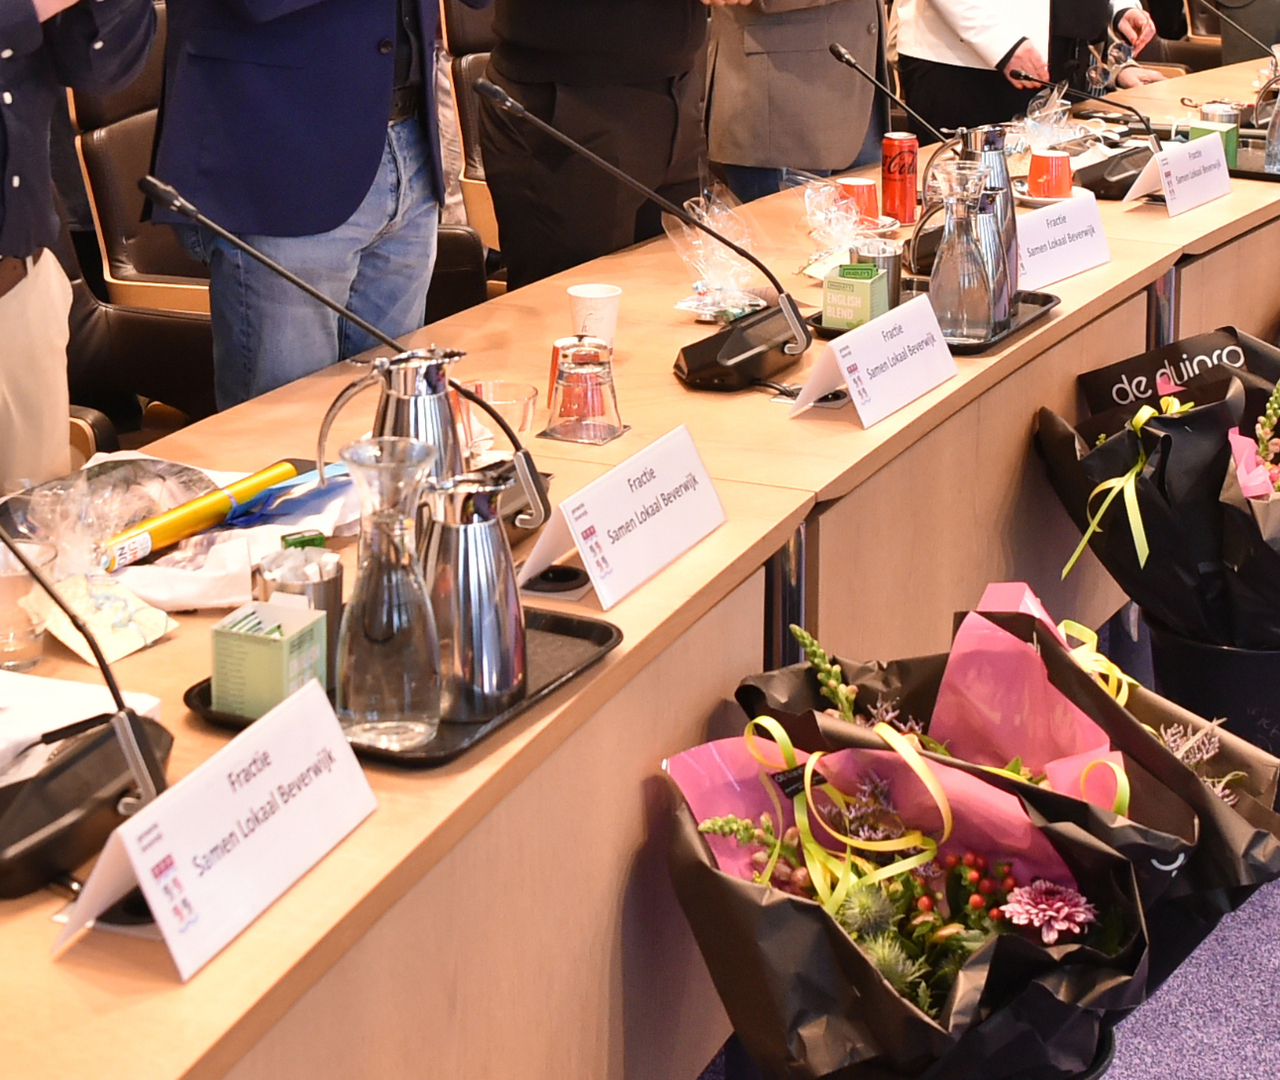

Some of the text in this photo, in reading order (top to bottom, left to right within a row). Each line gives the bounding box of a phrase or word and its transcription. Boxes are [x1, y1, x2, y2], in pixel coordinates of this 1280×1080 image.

[1045, 213, 1067, 229] Fractie
[1026, 224, 1096, 258] Samen Lokaal Beverwijk
[826, 306, 854, 319] BLEND
[827, 292, 862, 308] ENGLISH
[881, 323, 904, 343] Fractie
[866, 332, 937, 380] Samen Lokaal Beverwijk
[1111, 373, 1153, 405] de
[627, 467, 656, 493] Fractie
[606, 472, 699, 545] Samen Lokaal Beverwijk
[226, 749, 272, 793] Fractie
[192, 831, 239, 877] Samen
[237, 792, 281, 839] Lokaal
[277, 746, 337, 805] Beverwijk
